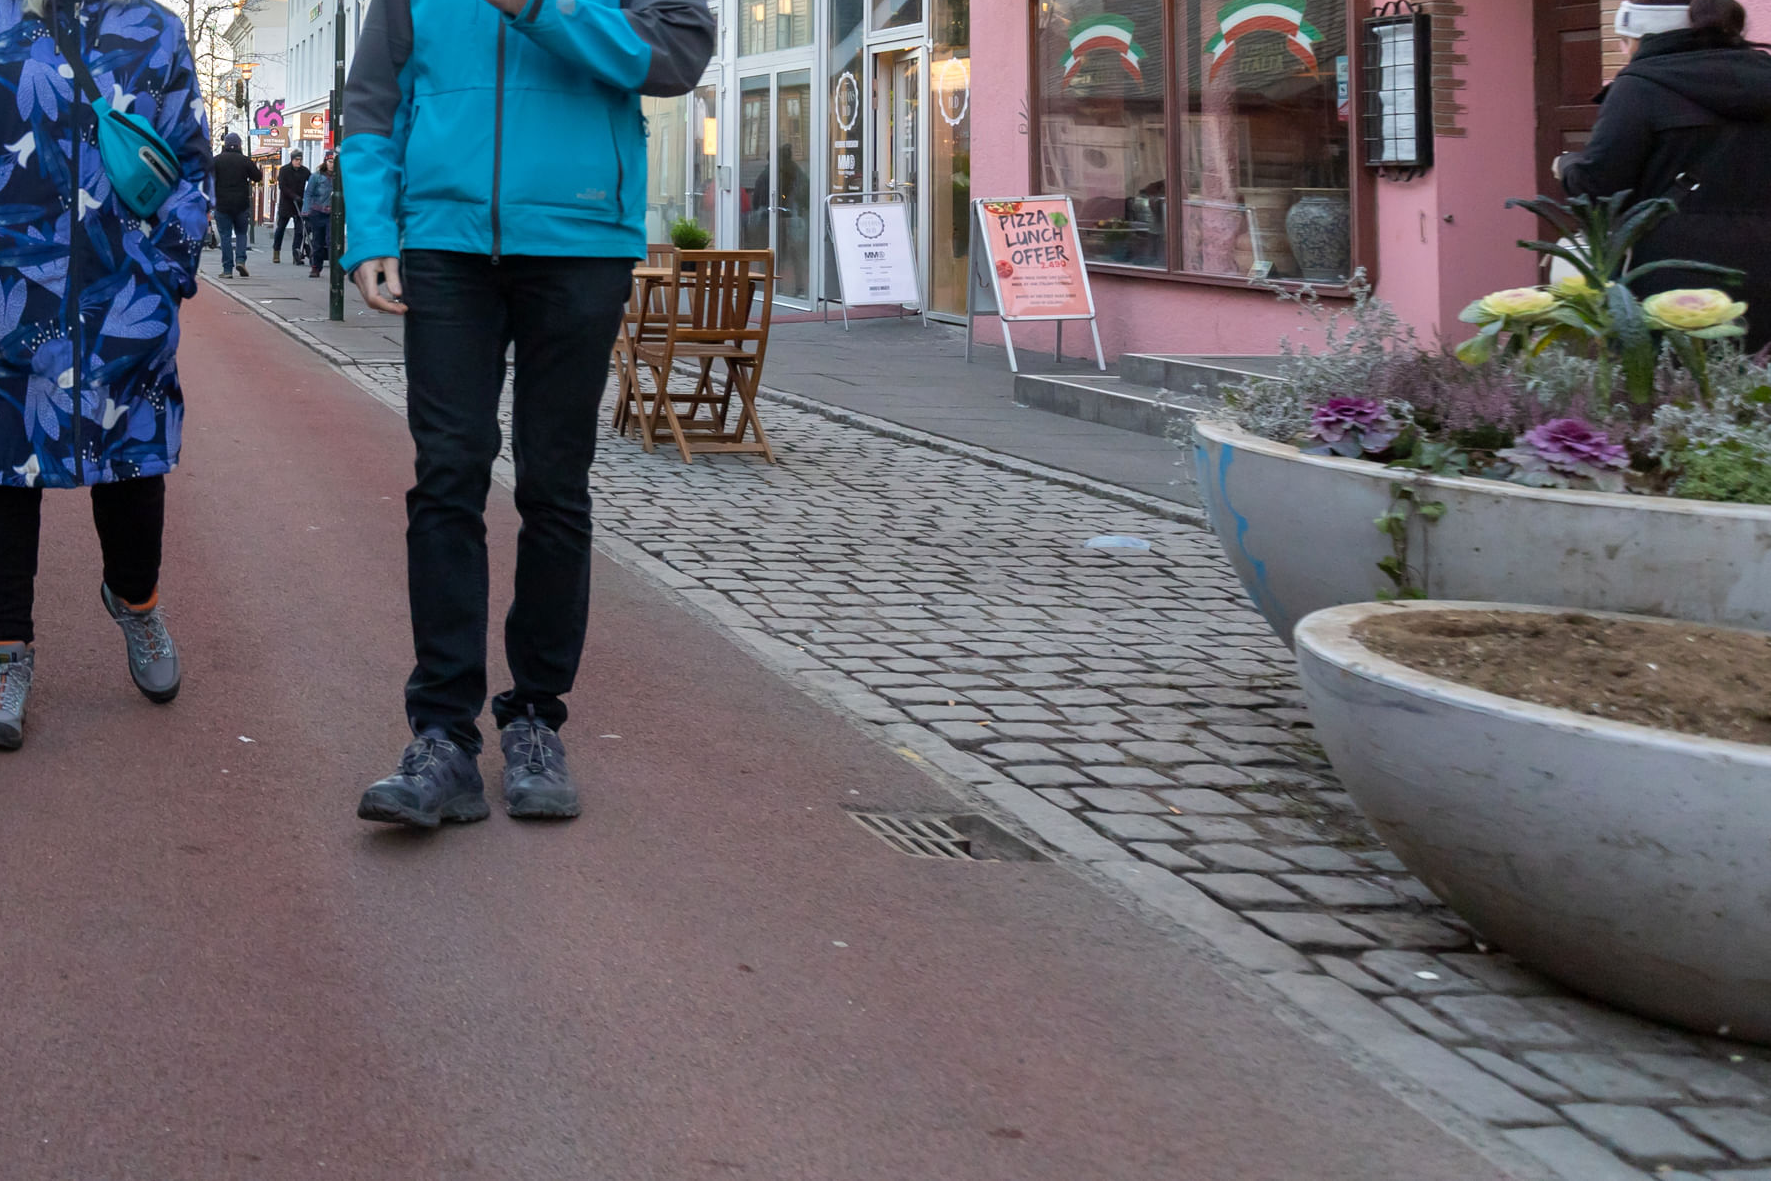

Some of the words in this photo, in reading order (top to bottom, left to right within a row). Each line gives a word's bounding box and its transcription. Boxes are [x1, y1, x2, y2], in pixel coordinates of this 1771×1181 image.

[999, 210, 1049, 231] PIZZA
[1005, 227, 1064, 248] LUNCH
[1011, 245, 1070, 265] OFFER
